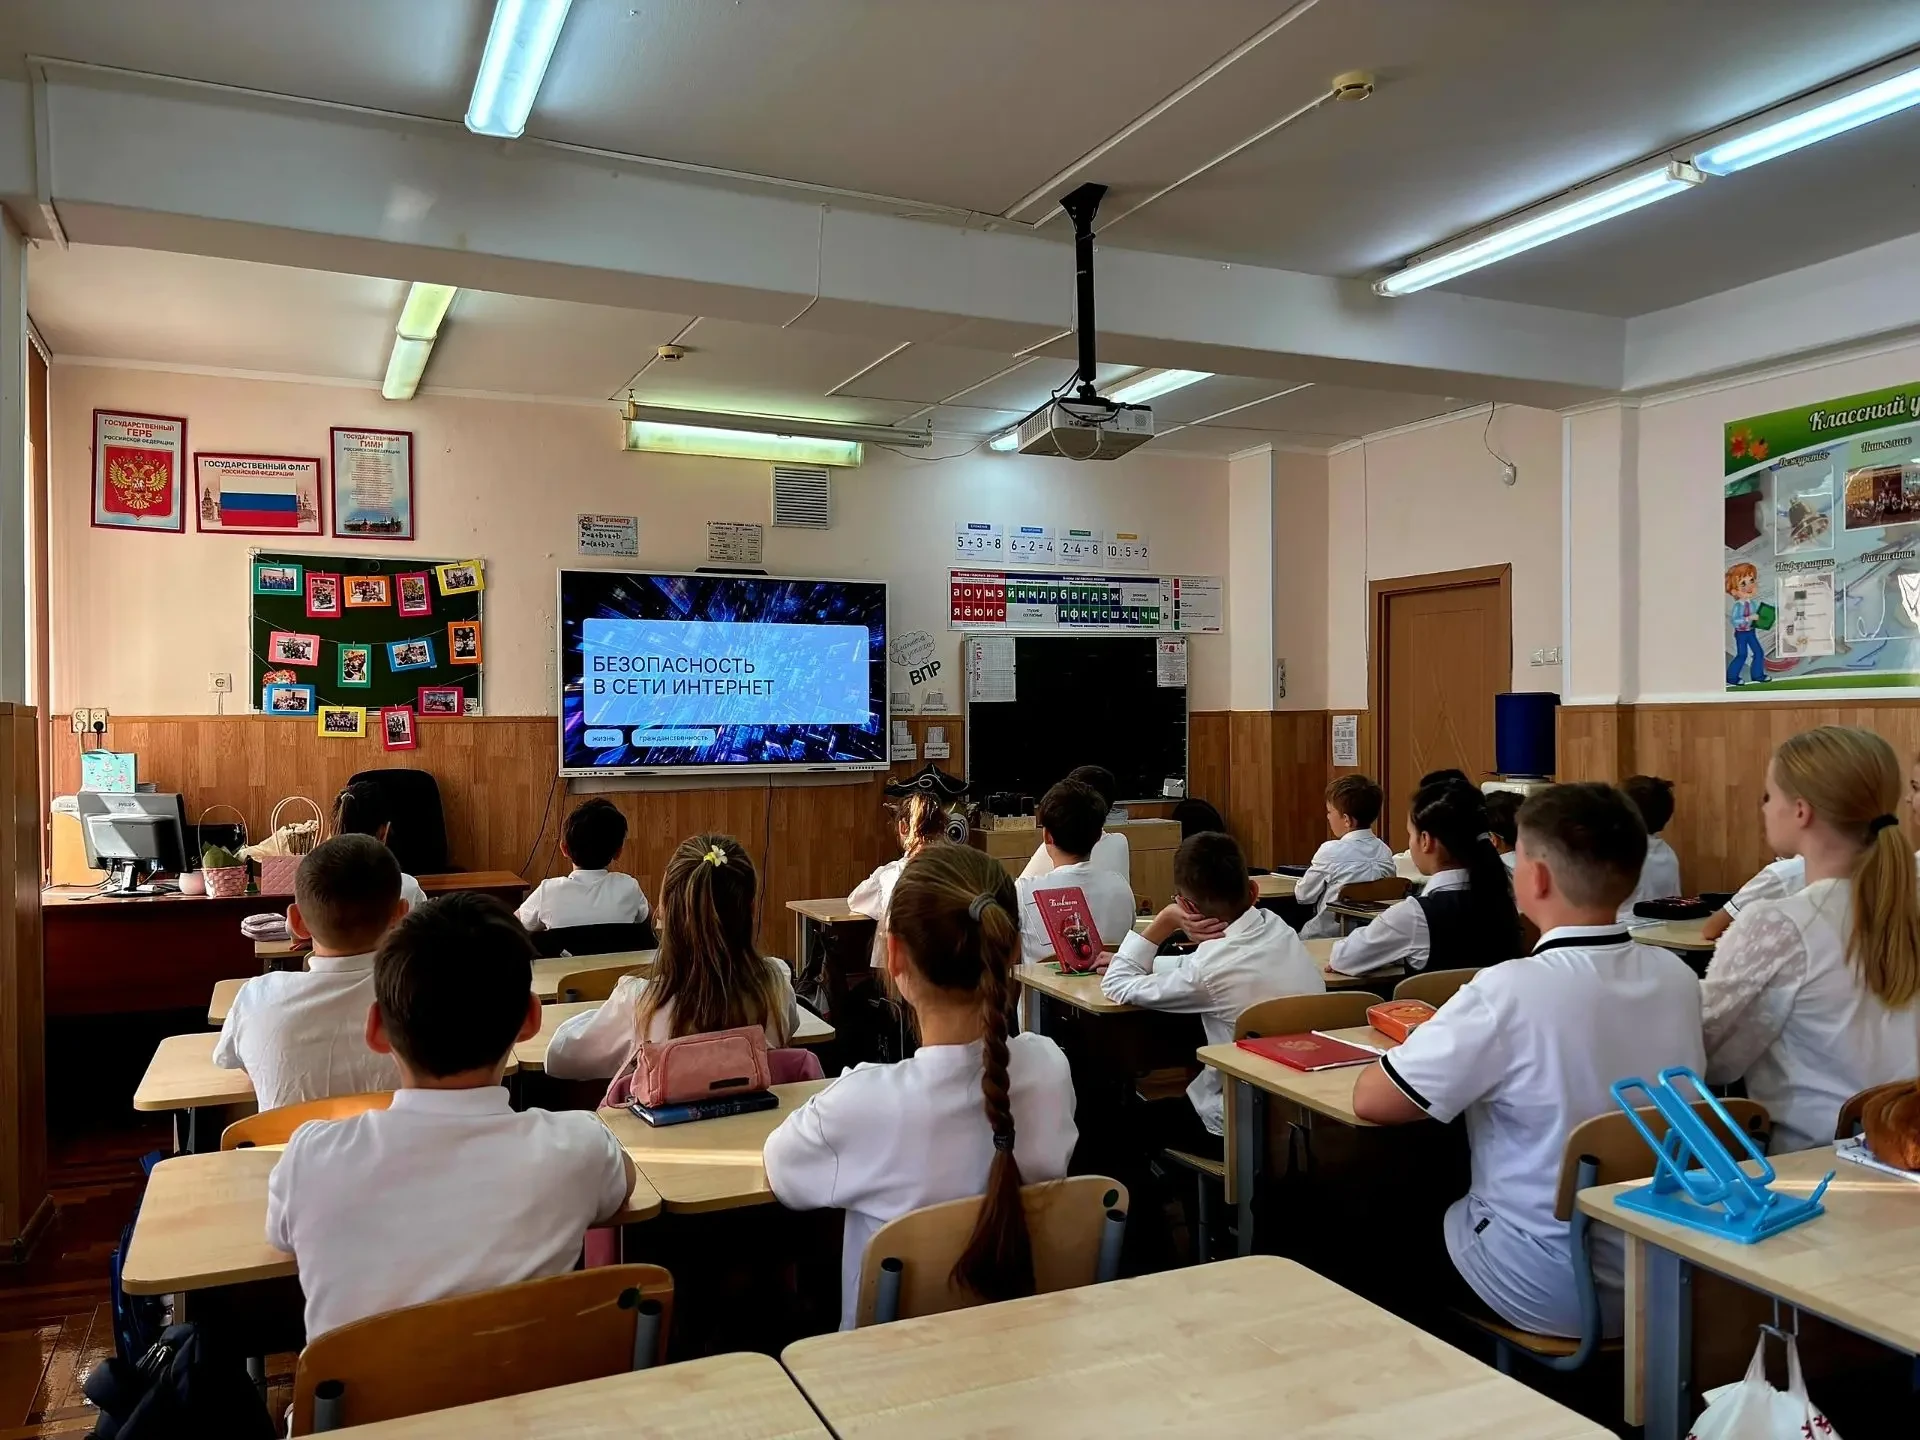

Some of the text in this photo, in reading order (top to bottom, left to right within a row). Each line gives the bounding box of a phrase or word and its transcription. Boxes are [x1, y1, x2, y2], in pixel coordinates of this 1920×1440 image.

[1809, 396, 1907, 432] Классный
[104, 419, 175, 432] ГОСУДАРСТВЕННЫЙ
[127, 428, 153, 438] ГЕРБ
[343, 433, 400, 442] ГОСУДАРСТВЕННЫЙ
[104, 435, 175, 446] РОССИЙСКОЙ ФЕДЕРАЦИИ
[360, 440, 384, 448] ГИМН
[204, 460, 287, 470] ГОСУДАРСТВЕННЫЙ
[221, 468, 260, 476] РОССИЙСКОЙ
[596, 515, 631, 525] Периметр
[1107, 545, 1117, 556] 10
[593, 655, 755, 674] БЕЗОПАСНОСТЬ
[909, 660, 941, 686] ВПР
[593, 679, 775, 695] В СЕТИ ИНТЕРНЕТ
[639, 734, 709, 743] гражданственность
[1048, 894, 1078, 907] Блокнот
